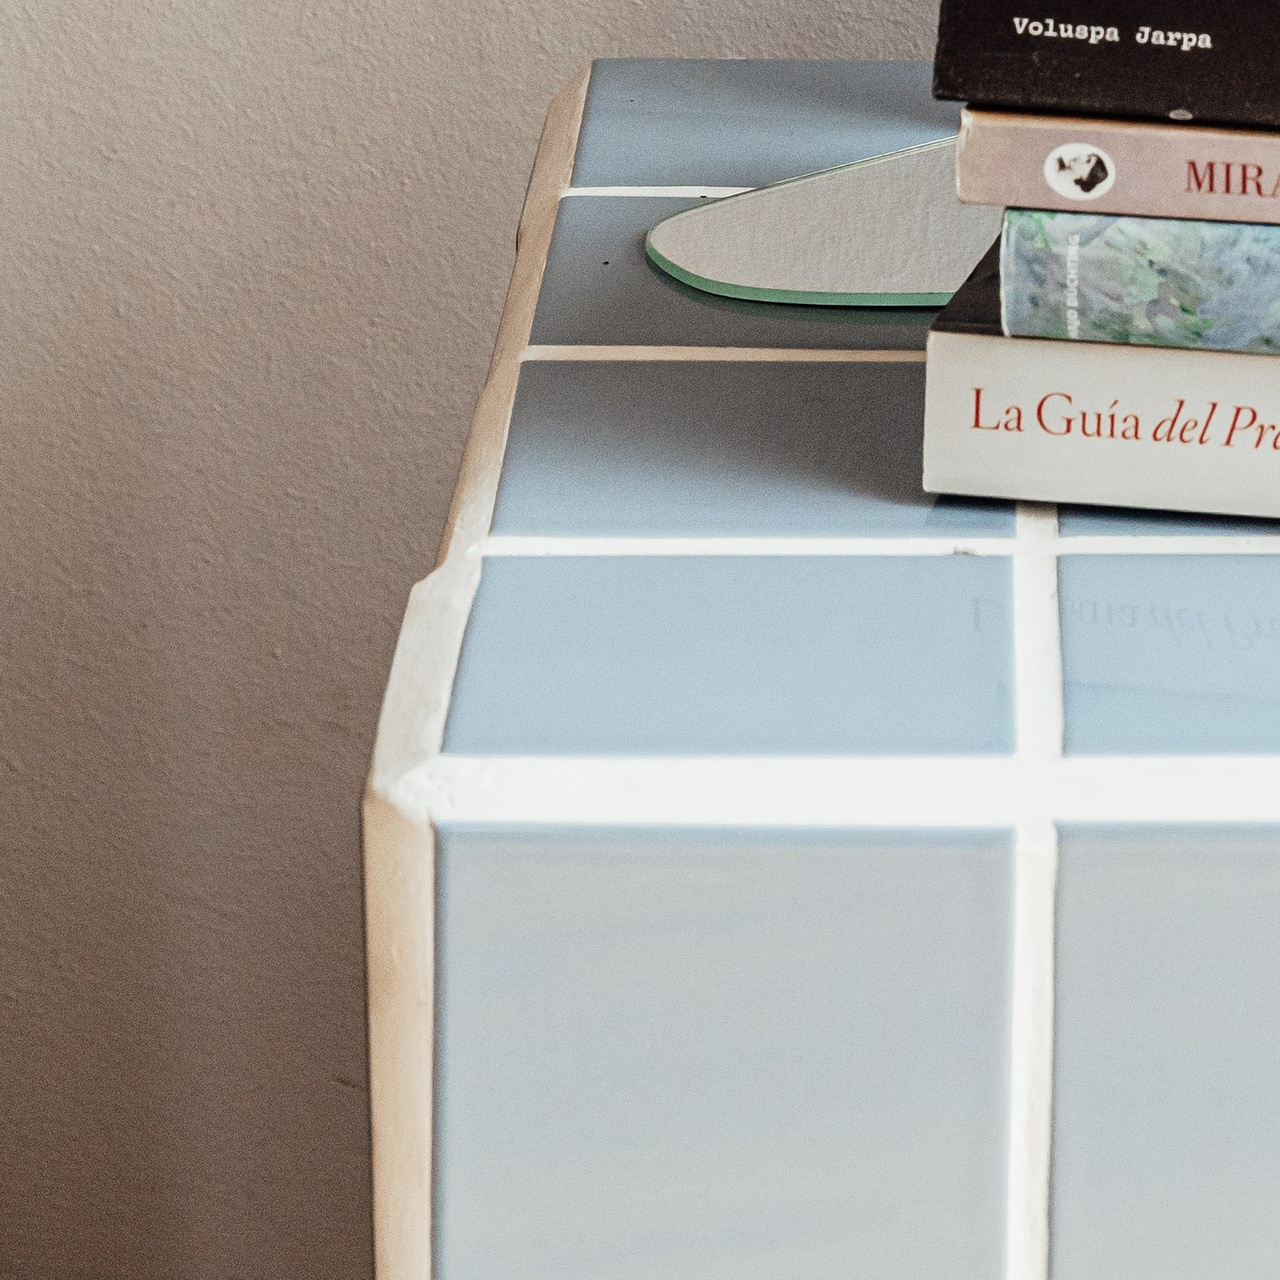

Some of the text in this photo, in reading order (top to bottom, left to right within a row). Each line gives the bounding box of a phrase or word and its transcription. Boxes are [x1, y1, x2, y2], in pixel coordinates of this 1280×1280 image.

[1012, 17, 1213, 51] Voluspa Jarpa
[971, 388, 1024, 433] La
[1036, 391, 1141, 441] Guía
[1153, 401, 1217, 445] del
